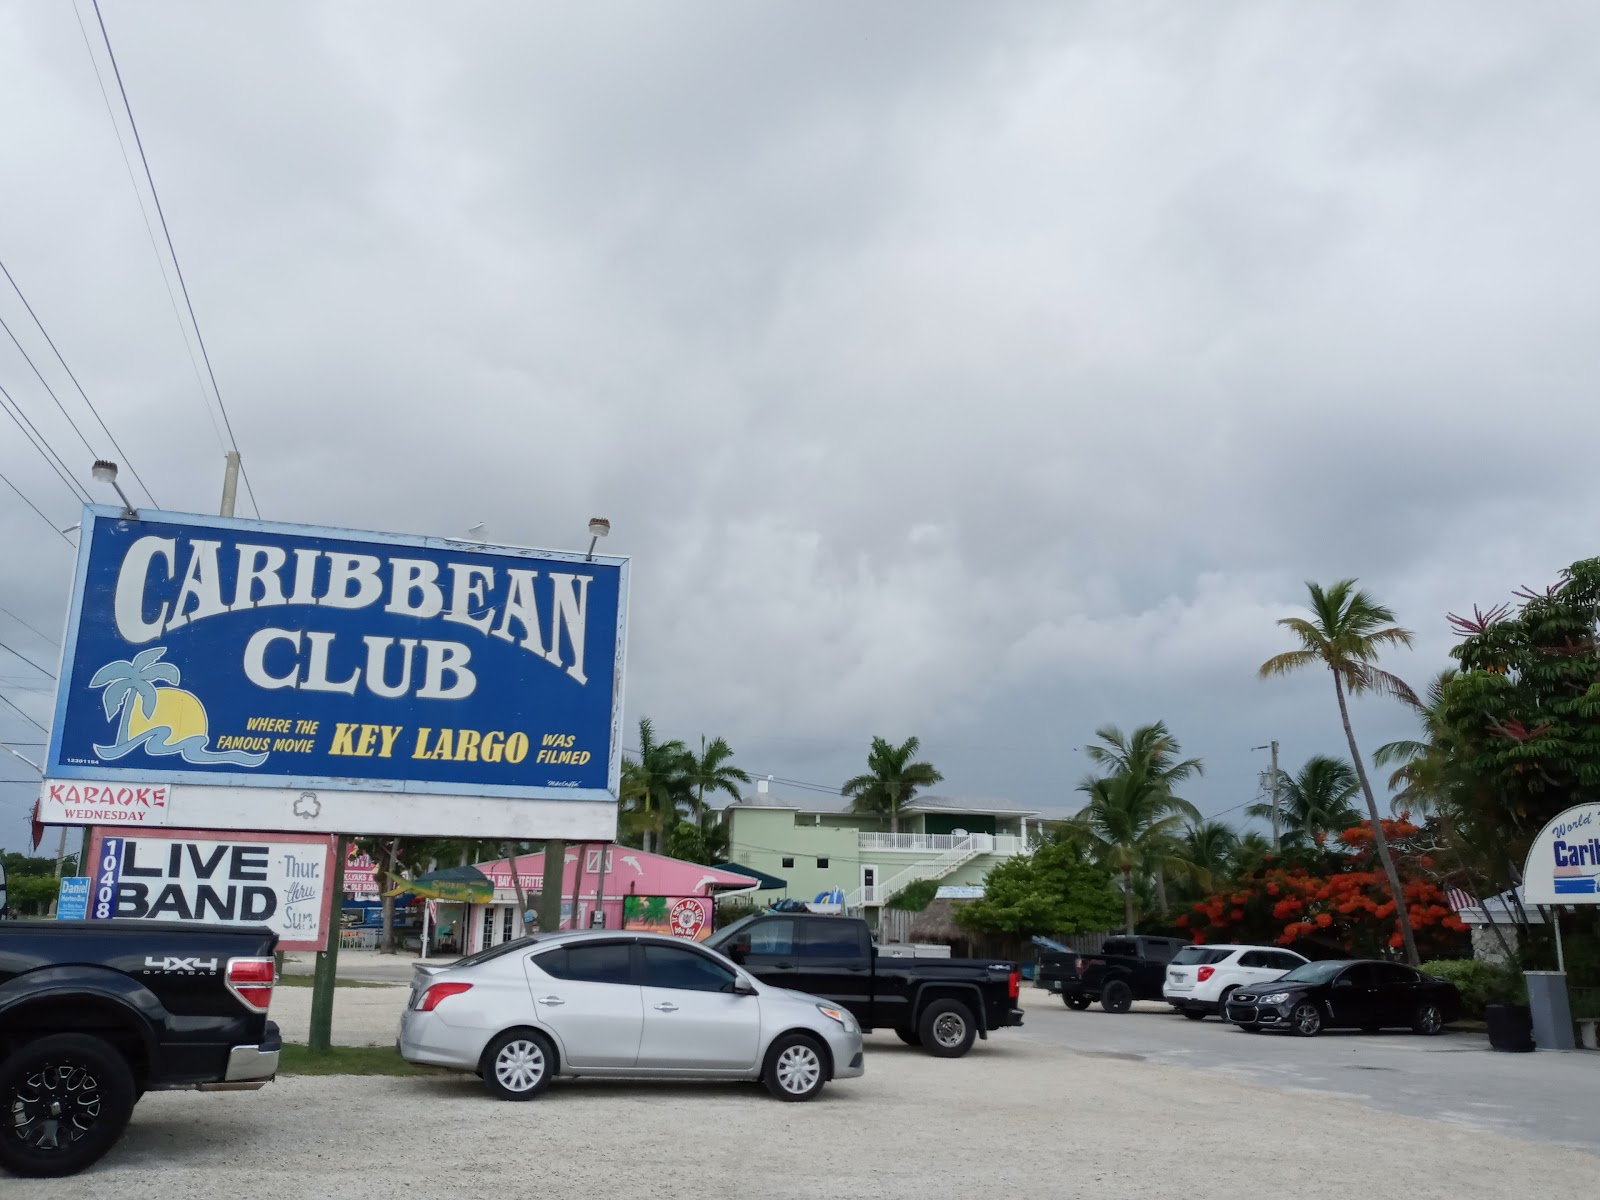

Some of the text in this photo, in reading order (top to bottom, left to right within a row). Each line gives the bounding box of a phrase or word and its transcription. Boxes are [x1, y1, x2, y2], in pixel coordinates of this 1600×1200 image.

[114, 536, 593, 686] CARIBBEAN
[244, 628, 476, 699] CLUB
[247, 717, 319, 734] WHERE THE
[217, 736, 314, 753] FAMOUS MOVIE
[328, 723, 529, 763] KEY LARGO
[542, 734, 575, 747] WAS
[537, 750, 590, 765] FILMED
[50, 784, 166, 807] KARAOKE
[65, 809, 146, 821] WEDNESDAY
[1552, 812, 1591, 838] World
[121, 841, 269, 880] LIVE
[284, 855, 319, 878] Thur.
[62, 879, 88, 894] Daniel
[96, 839, 117, 919] 10408
[497, 875, 511, 887] BAY
[511, 875, 544, 887] UTFITTE
[114, 882, 277, 921] BAND
[284, 881, 315, 902] thru
[283, 906, 316, 929] Sun.
